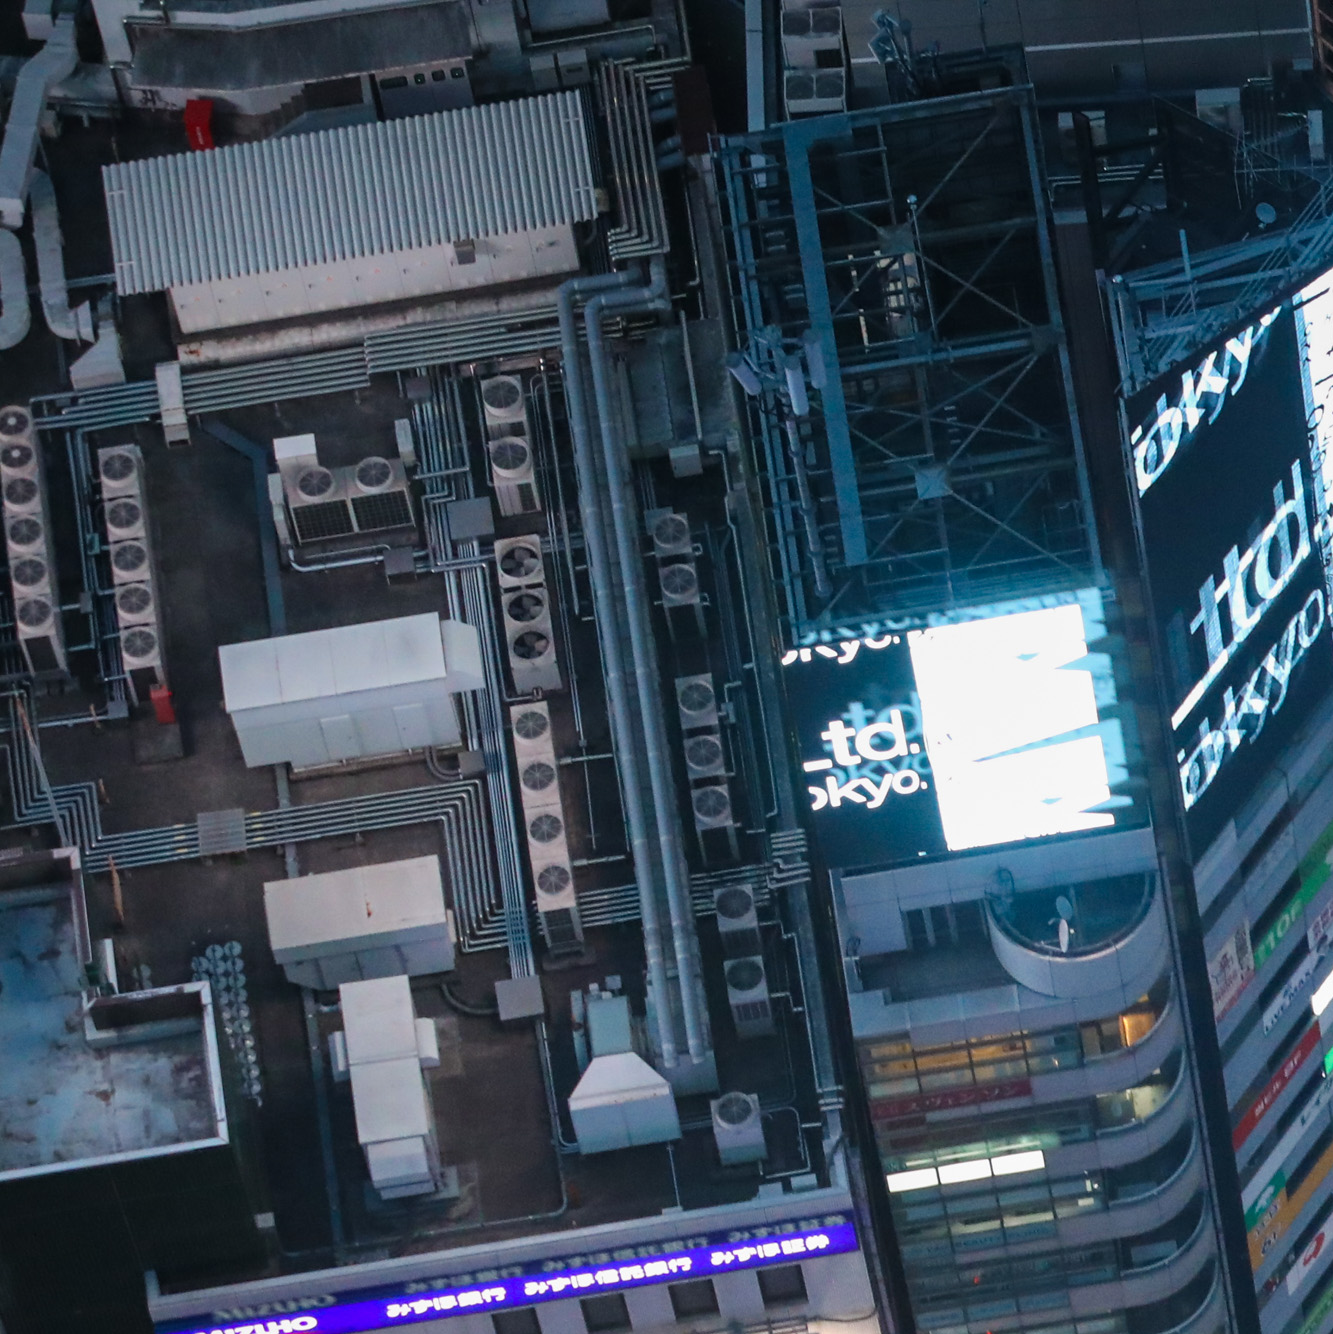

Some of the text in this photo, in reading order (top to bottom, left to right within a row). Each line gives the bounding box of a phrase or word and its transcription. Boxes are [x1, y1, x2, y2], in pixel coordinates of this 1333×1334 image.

[386, 1285, 508, 1318] みずほ銀行
[523, 1256, 692, 1295] みずほ信託銀行
[709, 1233, 830, 1267] みずほ証券
